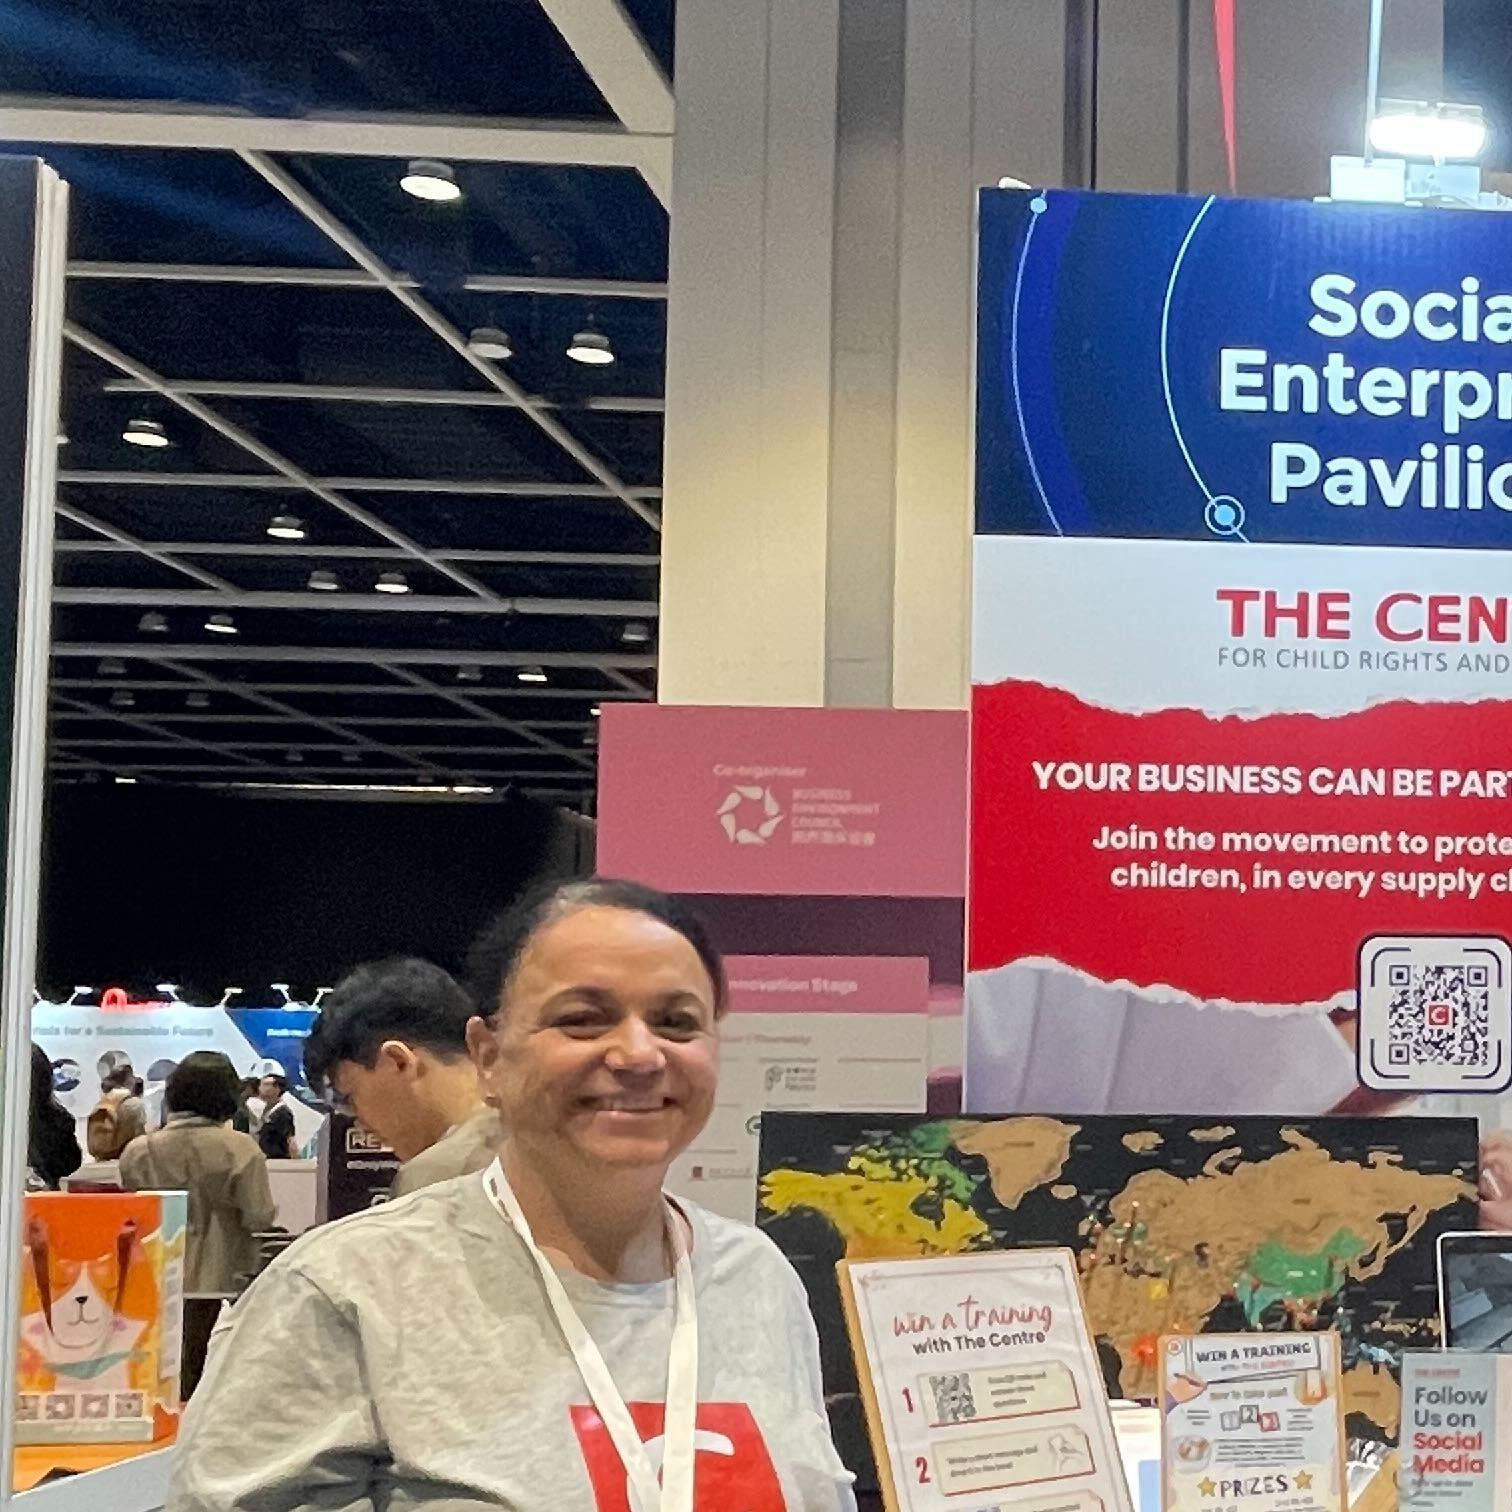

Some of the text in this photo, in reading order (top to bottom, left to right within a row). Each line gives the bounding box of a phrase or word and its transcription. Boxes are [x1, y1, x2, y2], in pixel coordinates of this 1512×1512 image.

[1216, 589, 1350, 640] THE
[1217, 646, 1267, 669] FOR
[1276, 648, 1350, 670] CHILD
[1359, 650, 1449, 673] RIGHTS
[1456, 652, 1511, 674] AND
[1032, 760, 1132, 792] YOUR
[1138, 763, 1303, 795] BUSINESS
[1308, 766, 1386, 796] CAN
[1392, 768, 1434, 797] BE
[1092, 823, 1158, 850] Join
[1163, 825, 1216, 851] the
[1222, 830, 1392, 854] movement
[1396, 830, 1429, 855] to
[1110, 860, 1247, 894] children,
[1252, 862, 1282, 890] in
[1287, 870, 1376, 898] every
[1380, 866, 1486, 900] supply
[893, 1295, 1053, 1337] win a training
[912, 1330, 1046, 1355] with The Centre
[1196, 1342, 1312, 1363] WIN A TRAINING
[902, 1386, 914, 1414] 1
[1414, 1385, 1488, 1406] Follow
[1413, 1408, 1477, 1428] Us on
[1412, 1430, 1483, 1451] Social
[915, 1455, 932, 1484] 2
[1412, 1453, 1485, 1474] Media
[1219, 1474, 1289, 1498] PRIZES
